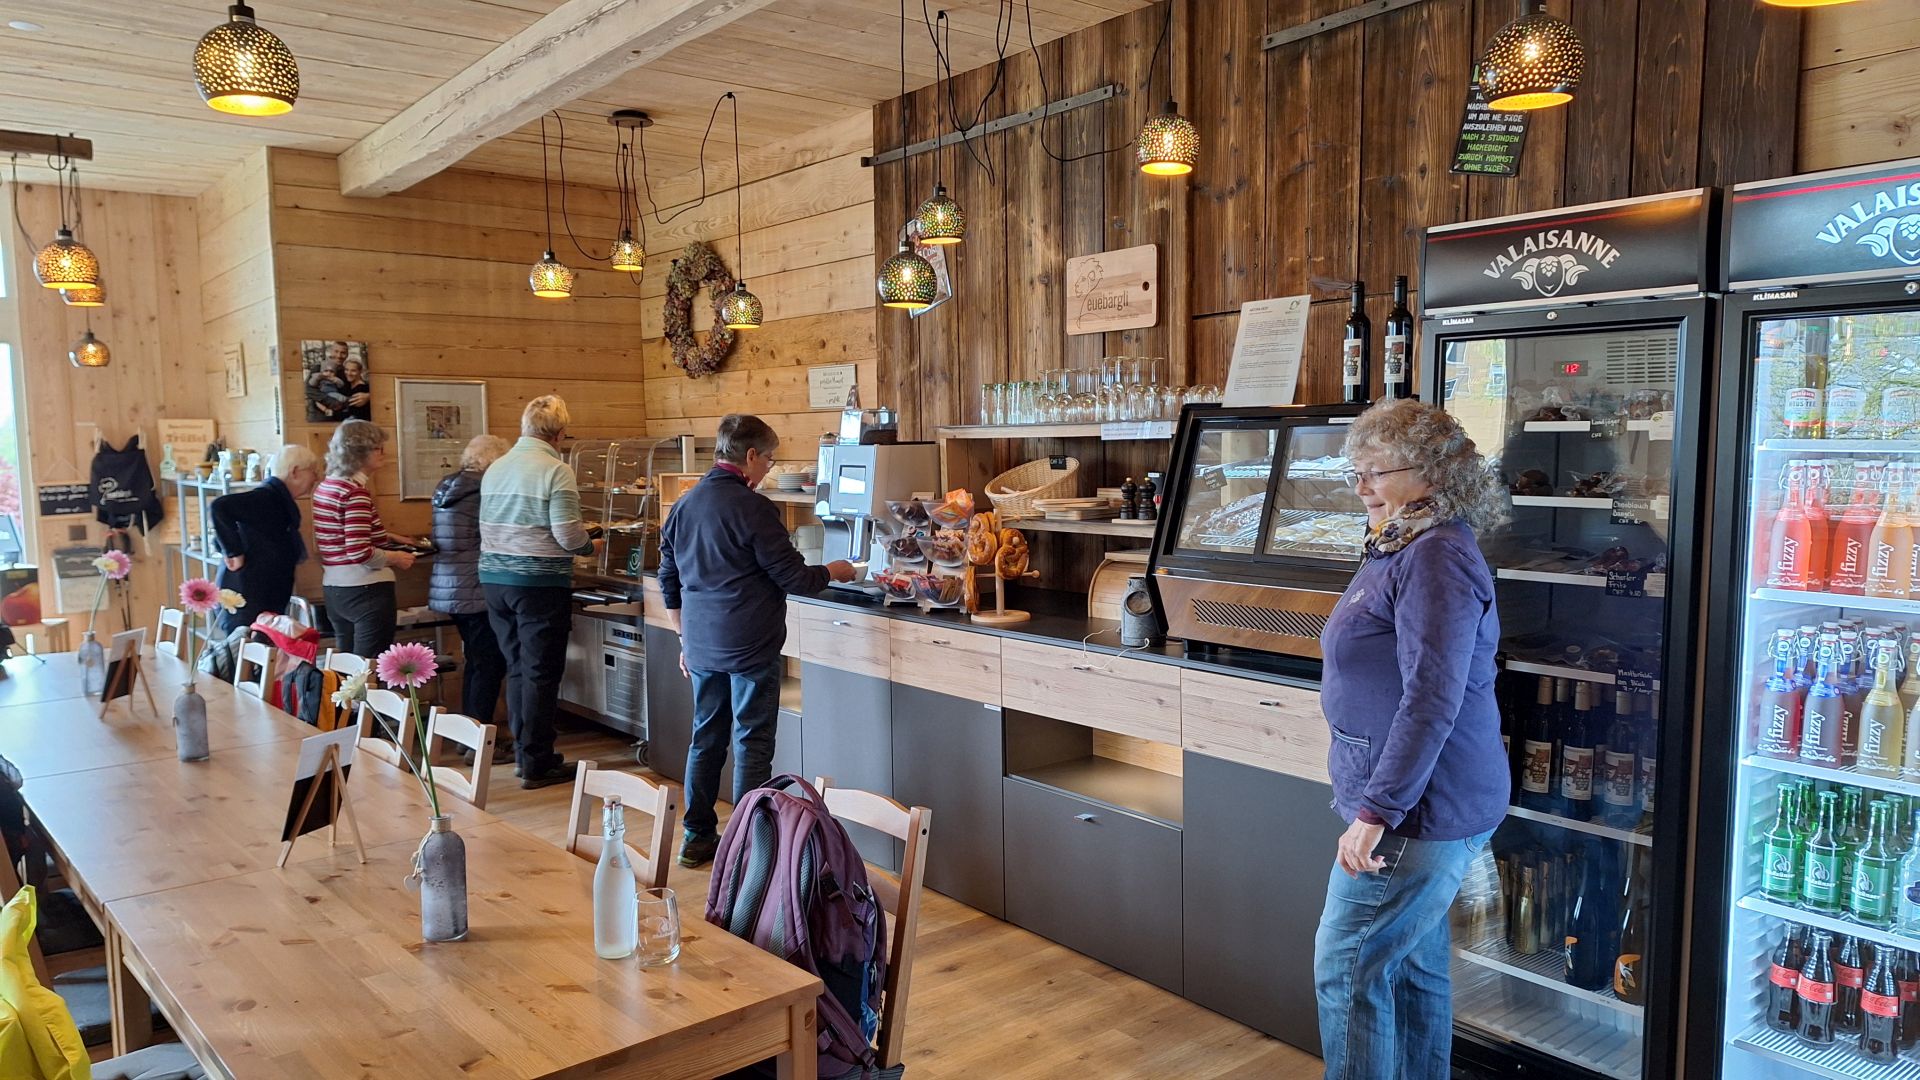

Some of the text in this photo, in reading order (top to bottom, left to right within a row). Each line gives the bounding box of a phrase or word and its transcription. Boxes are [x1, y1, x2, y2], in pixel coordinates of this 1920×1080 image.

[1463, 123, 1524, 133] AUSZULEIHEN UND
[1479, 113, 1490, 121] DIR
[1462, 133, 1479, 141] NACH
[1488, 134, 1520, 143] STUNDEN
[1467, 143, 1508, 152] HACKEDICHT
[1458, 153, 1514, 163] ZURÜCK KOMMST
[1463, 163, 1482, 171] OHNE
[1483, 229, 1621, 280] VALAISANNE
[1777, 536, 1799, 572] fizzy
[1840, 537, 1863, 573] fizzy
[1871, 540, 1895, 578] fizzy
[1767, 704, 1789, 739] fizzy
[1804, 709, 1826, 746] fizzy
[1863, 718, 1886, 755] fizzy
